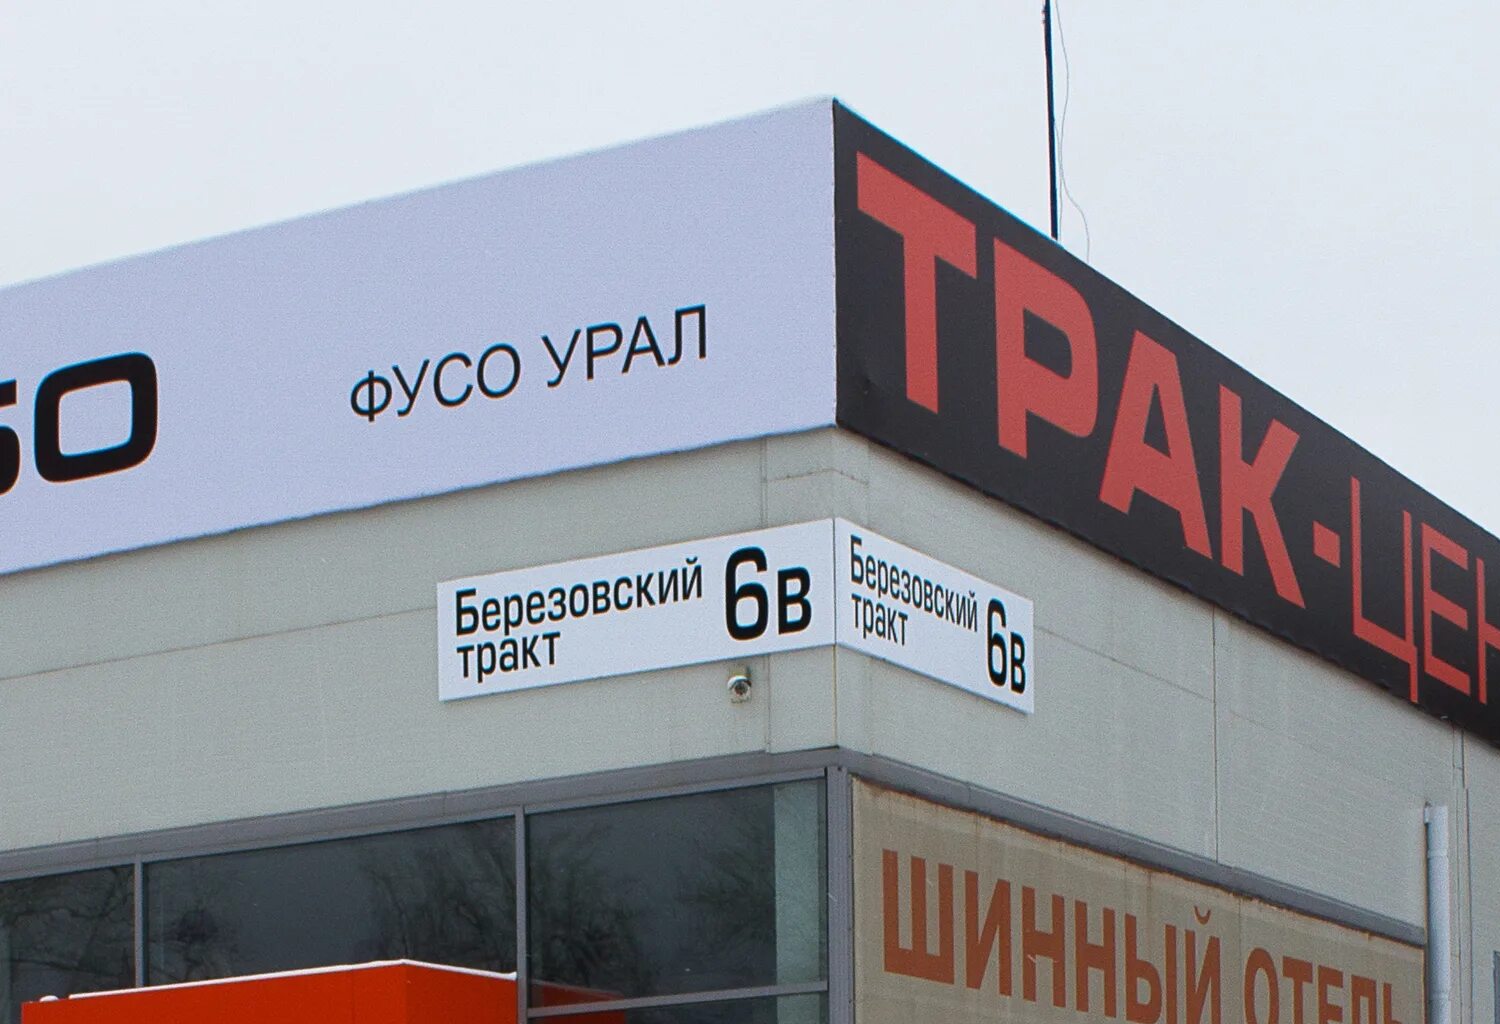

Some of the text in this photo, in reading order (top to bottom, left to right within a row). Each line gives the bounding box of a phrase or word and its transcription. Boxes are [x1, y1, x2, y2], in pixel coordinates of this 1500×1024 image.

[350, 303, 706, 422] ФУСО УРАЛ
[455, 556, 702, 636] Березовский
[850, 534, 978, 632] Березовский
[851, 593, 908, 647] тракт
[456, 631, 561, 683] тракт
